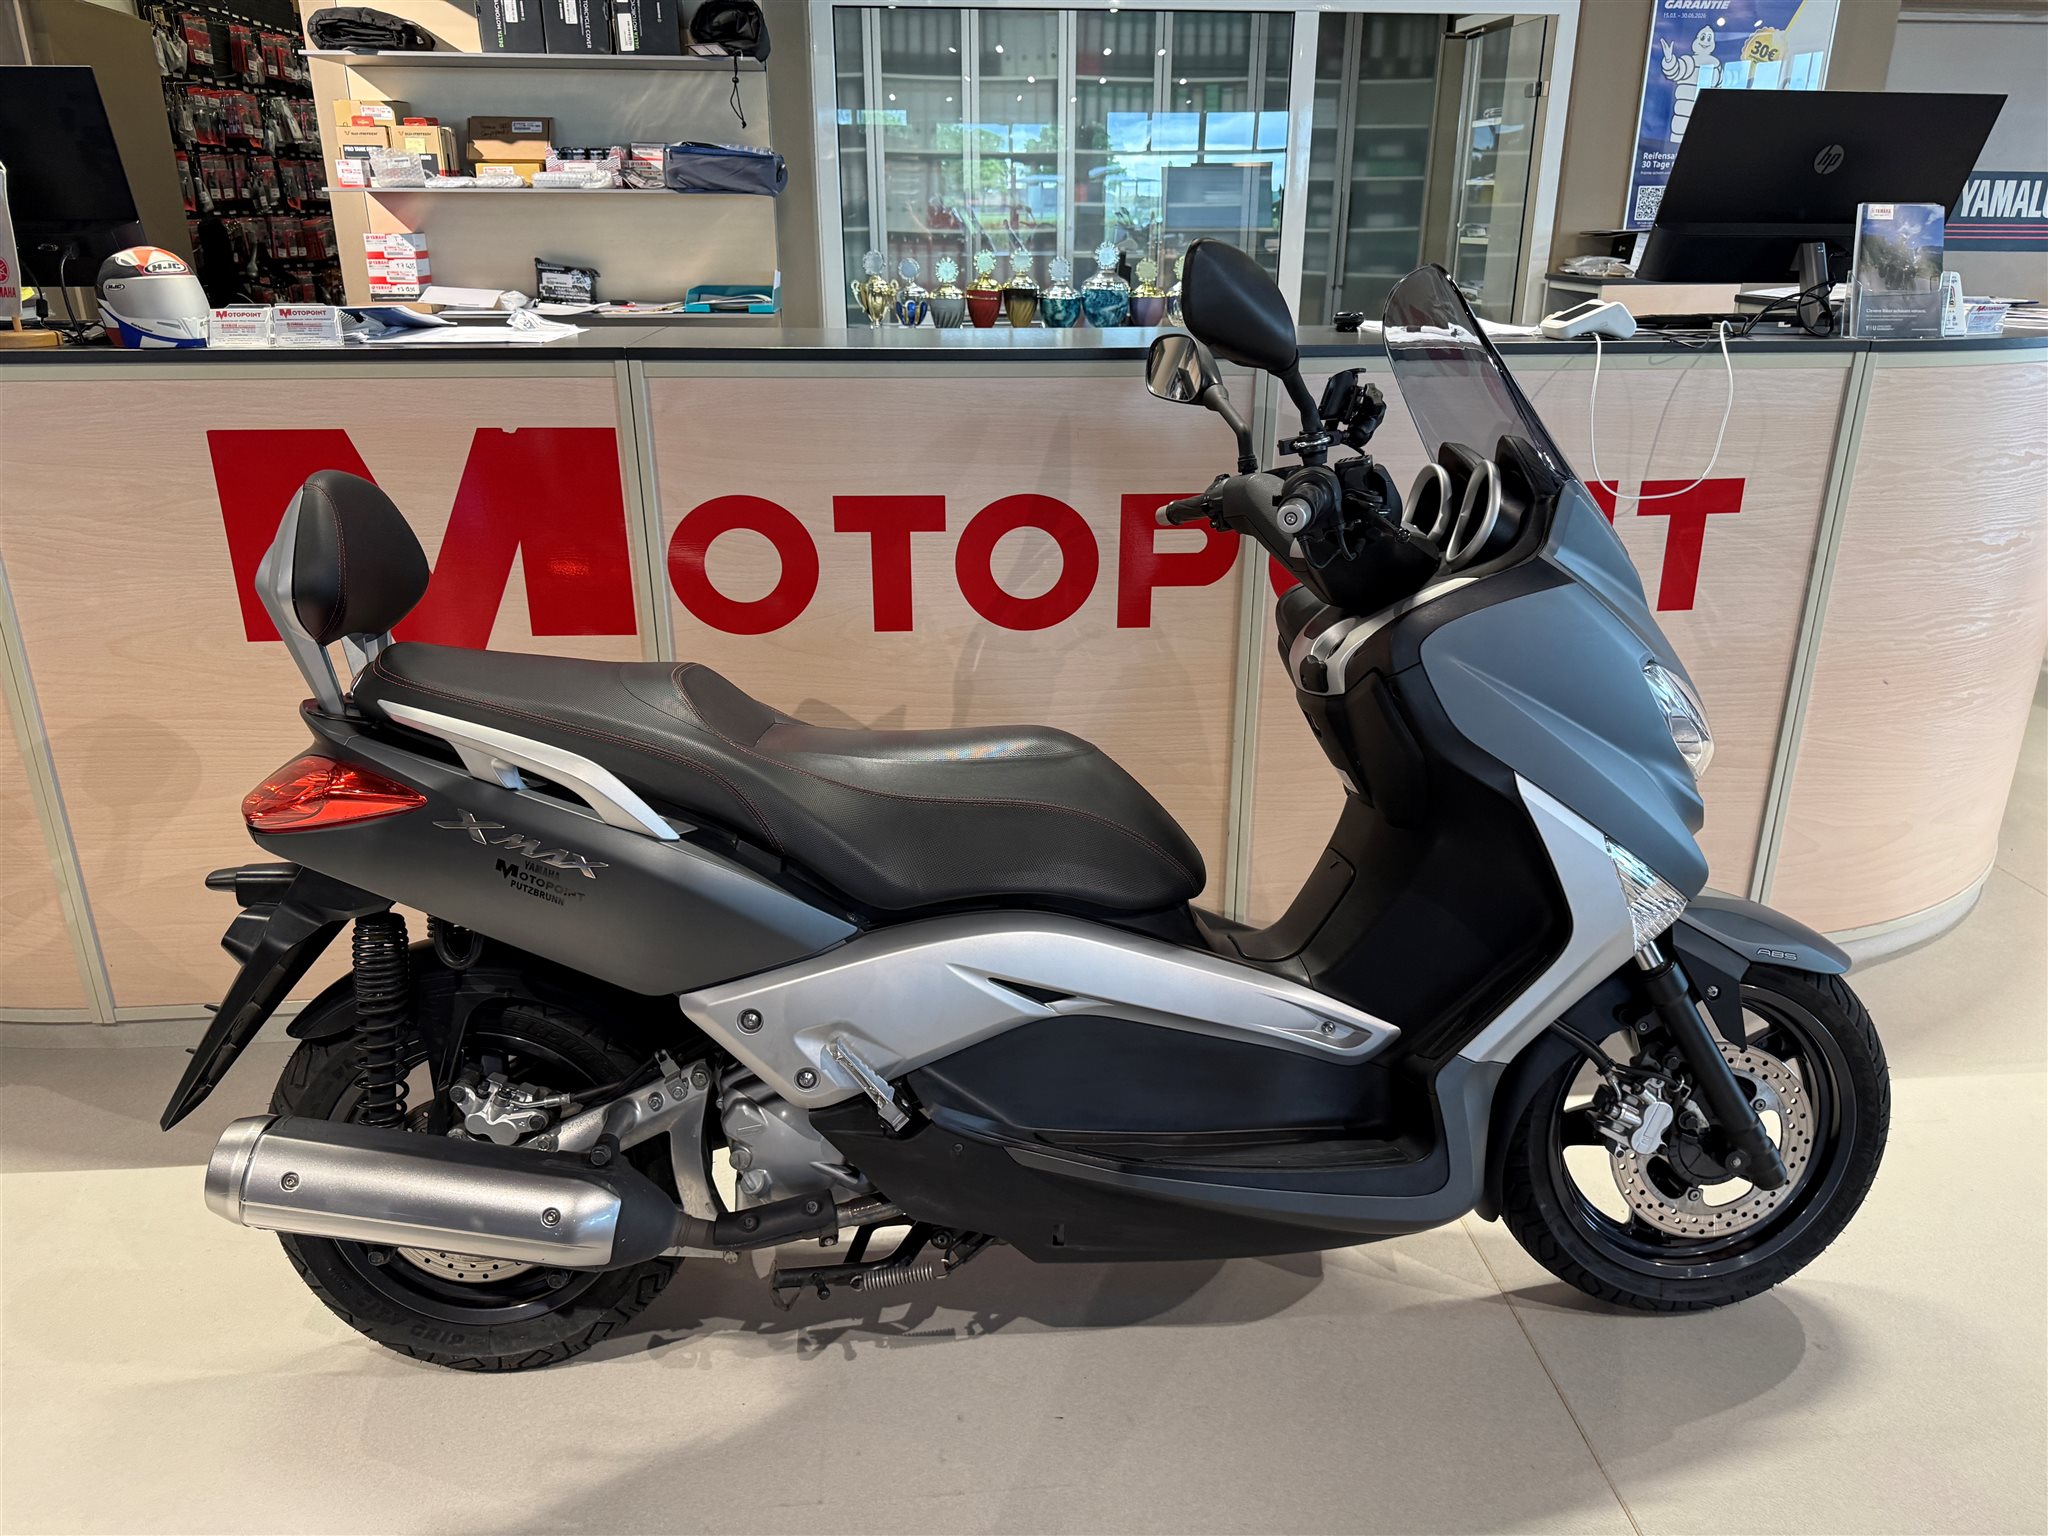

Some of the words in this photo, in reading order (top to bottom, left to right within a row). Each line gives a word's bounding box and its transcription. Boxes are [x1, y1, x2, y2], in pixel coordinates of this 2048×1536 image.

[1664, 0, 1731, 10] GARANTIE
[1750, 40, 1778, 61] 30€
[1641, 161, 1651, 169] 30
[1653, 161, 1671, 170] Tage
[1815, 145, 1843, 174] hp
[151, 263, 181, 272] HJC
[216, 311, 261, 319] MOTOPOINT
[280, 309, 326, 318] MOTOPOINT
[206, 427, 1746, 650] MOTOPT
[524, 860, 560, 880] YAMAHA
[510, 880, 565, 906] PUTZBRUNN
[1757, 948, 1797, 961] ABS
